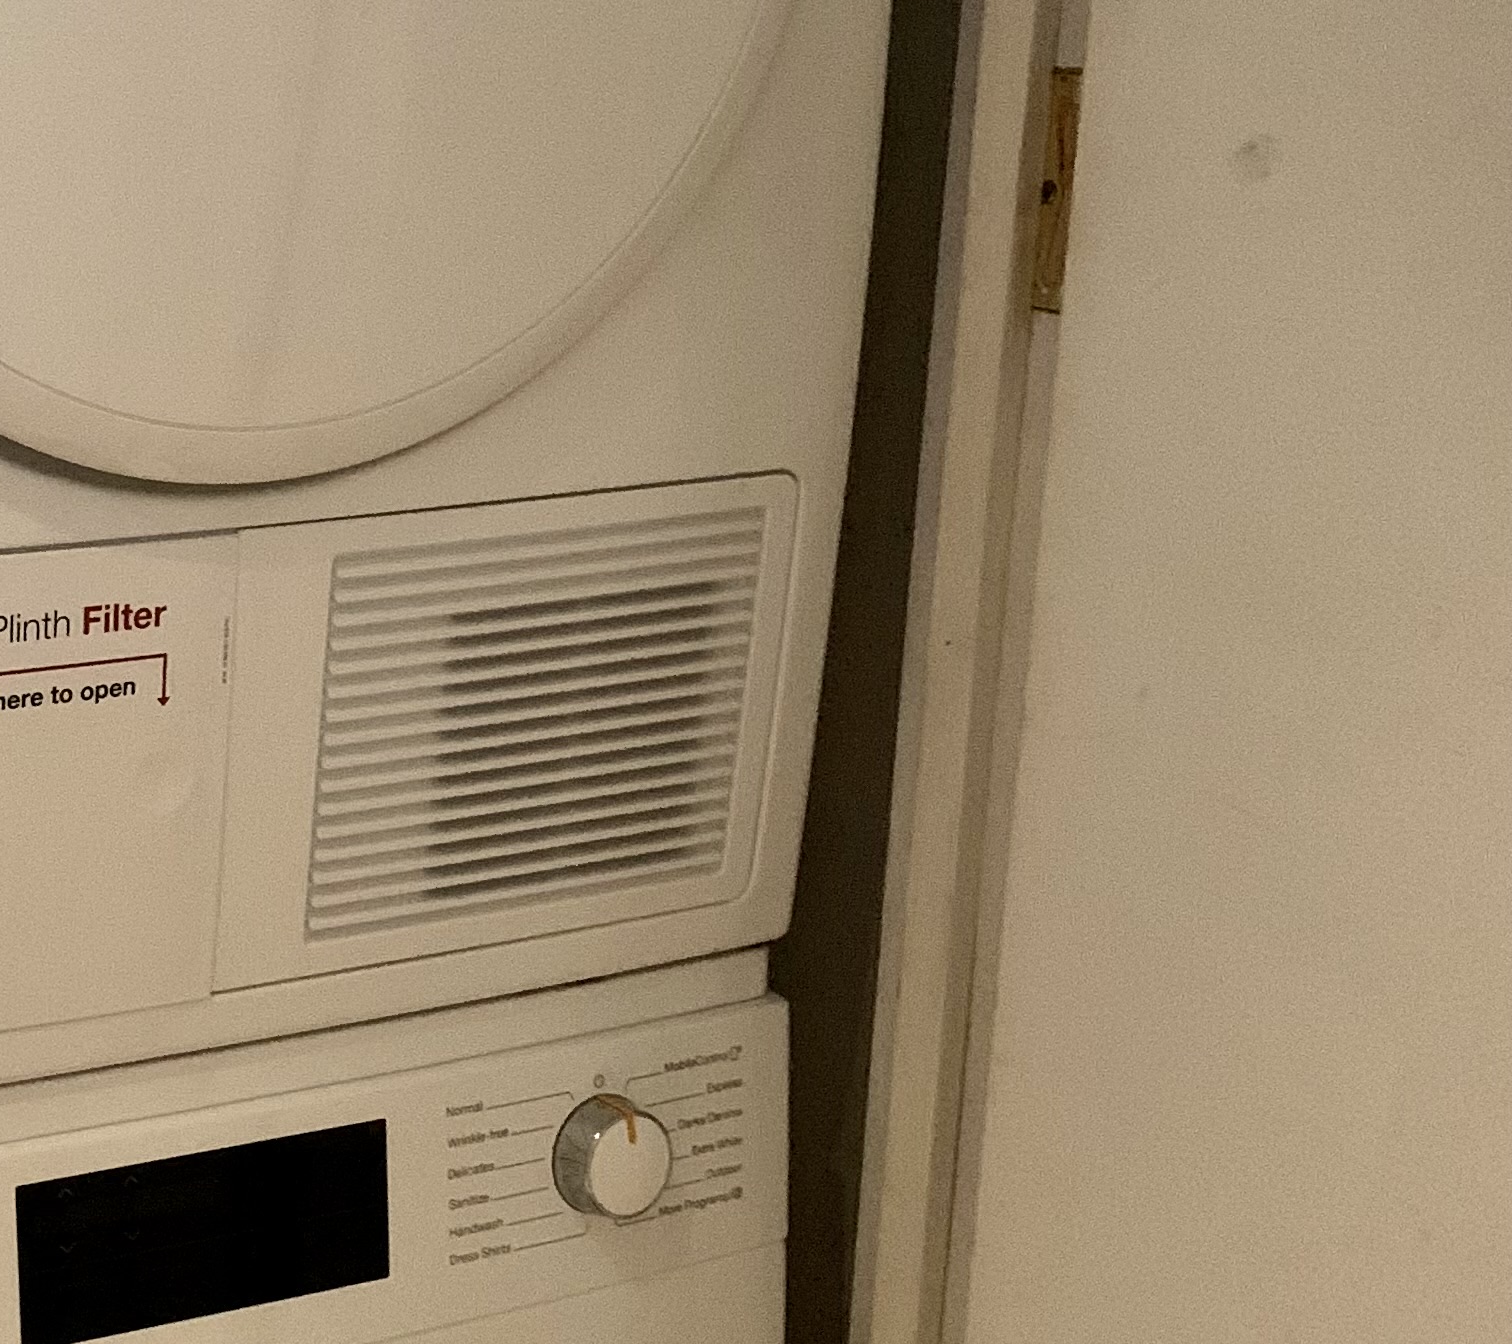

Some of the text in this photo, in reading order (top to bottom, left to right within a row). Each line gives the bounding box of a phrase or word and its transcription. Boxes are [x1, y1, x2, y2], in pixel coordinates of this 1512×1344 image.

[82, 603, 168, 636] Filter
[51, 685, 74, 705] to
[80, 678, 137, 702] open
